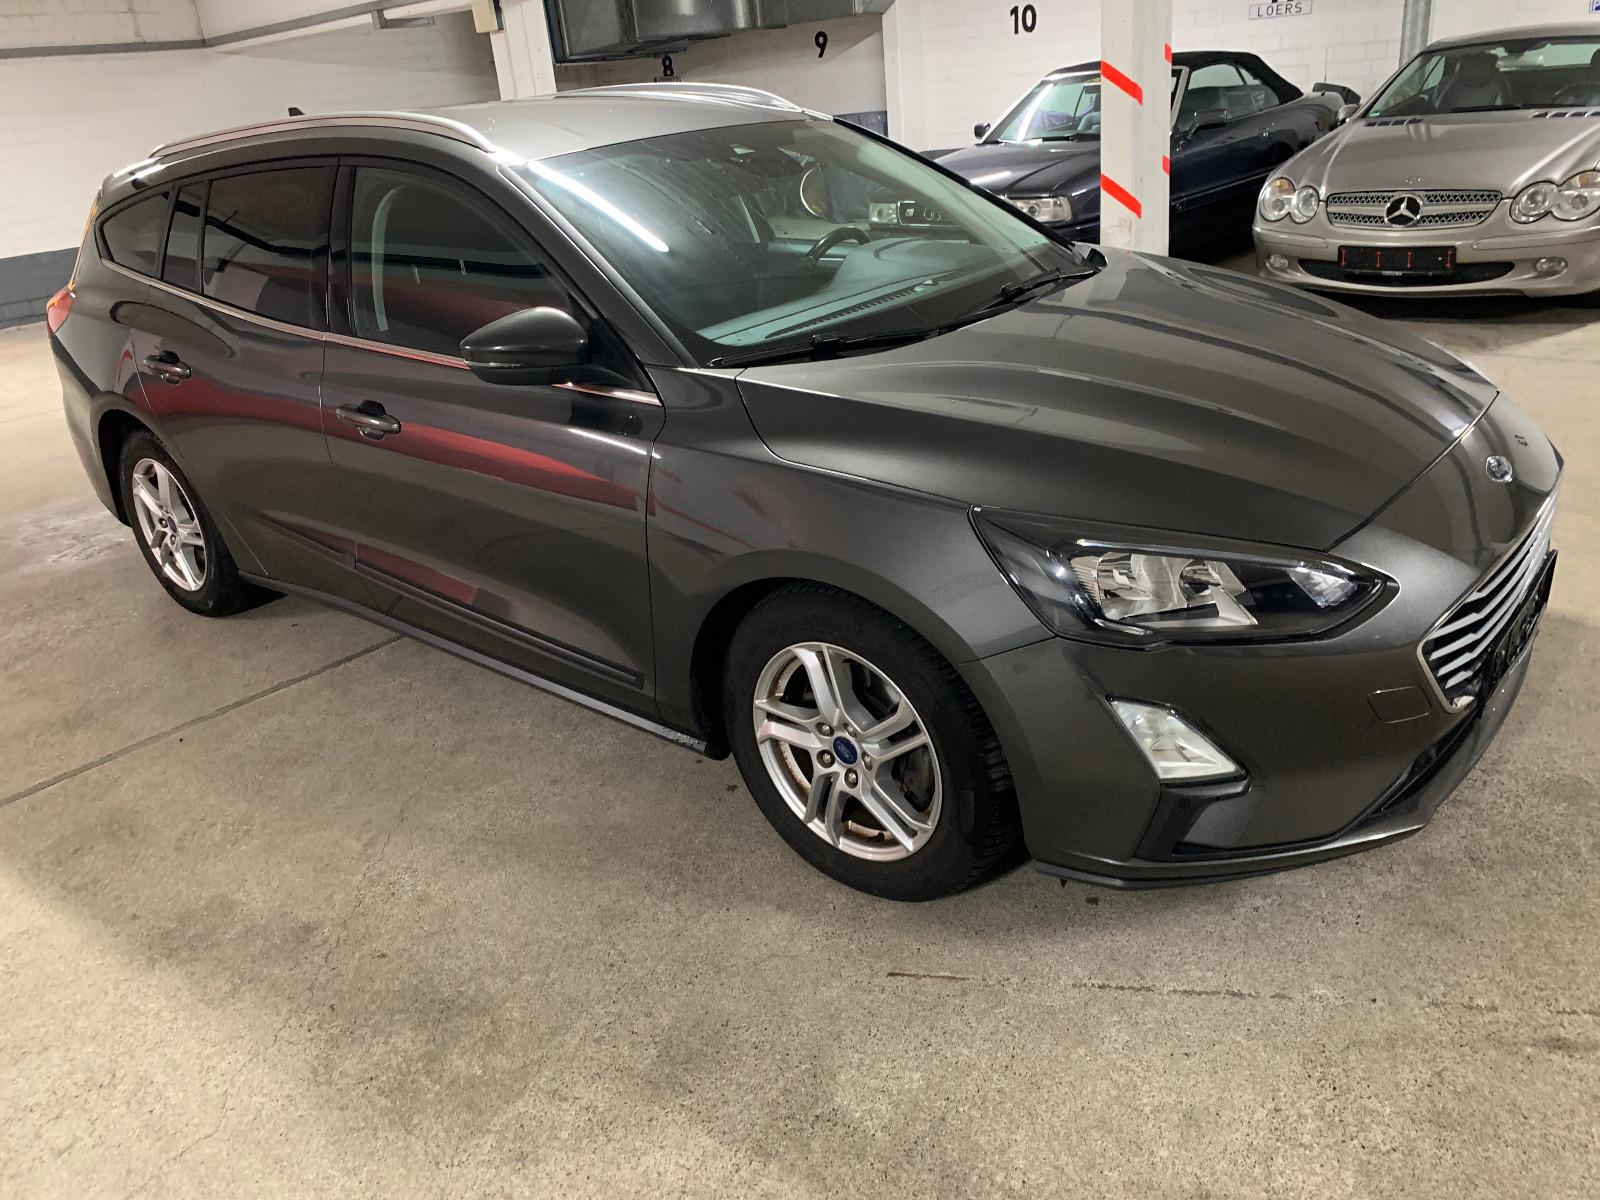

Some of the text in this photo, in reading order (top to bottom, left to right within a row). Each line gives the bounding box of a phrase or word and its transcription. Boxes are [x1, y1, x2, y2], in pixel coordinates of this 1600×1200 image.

[1010, 4, 1037, 35] 10
[1257, 2, 1302, 17] LOERS
[815, 31, 828, 58] 9
[662, 55, 675, 77] 8
